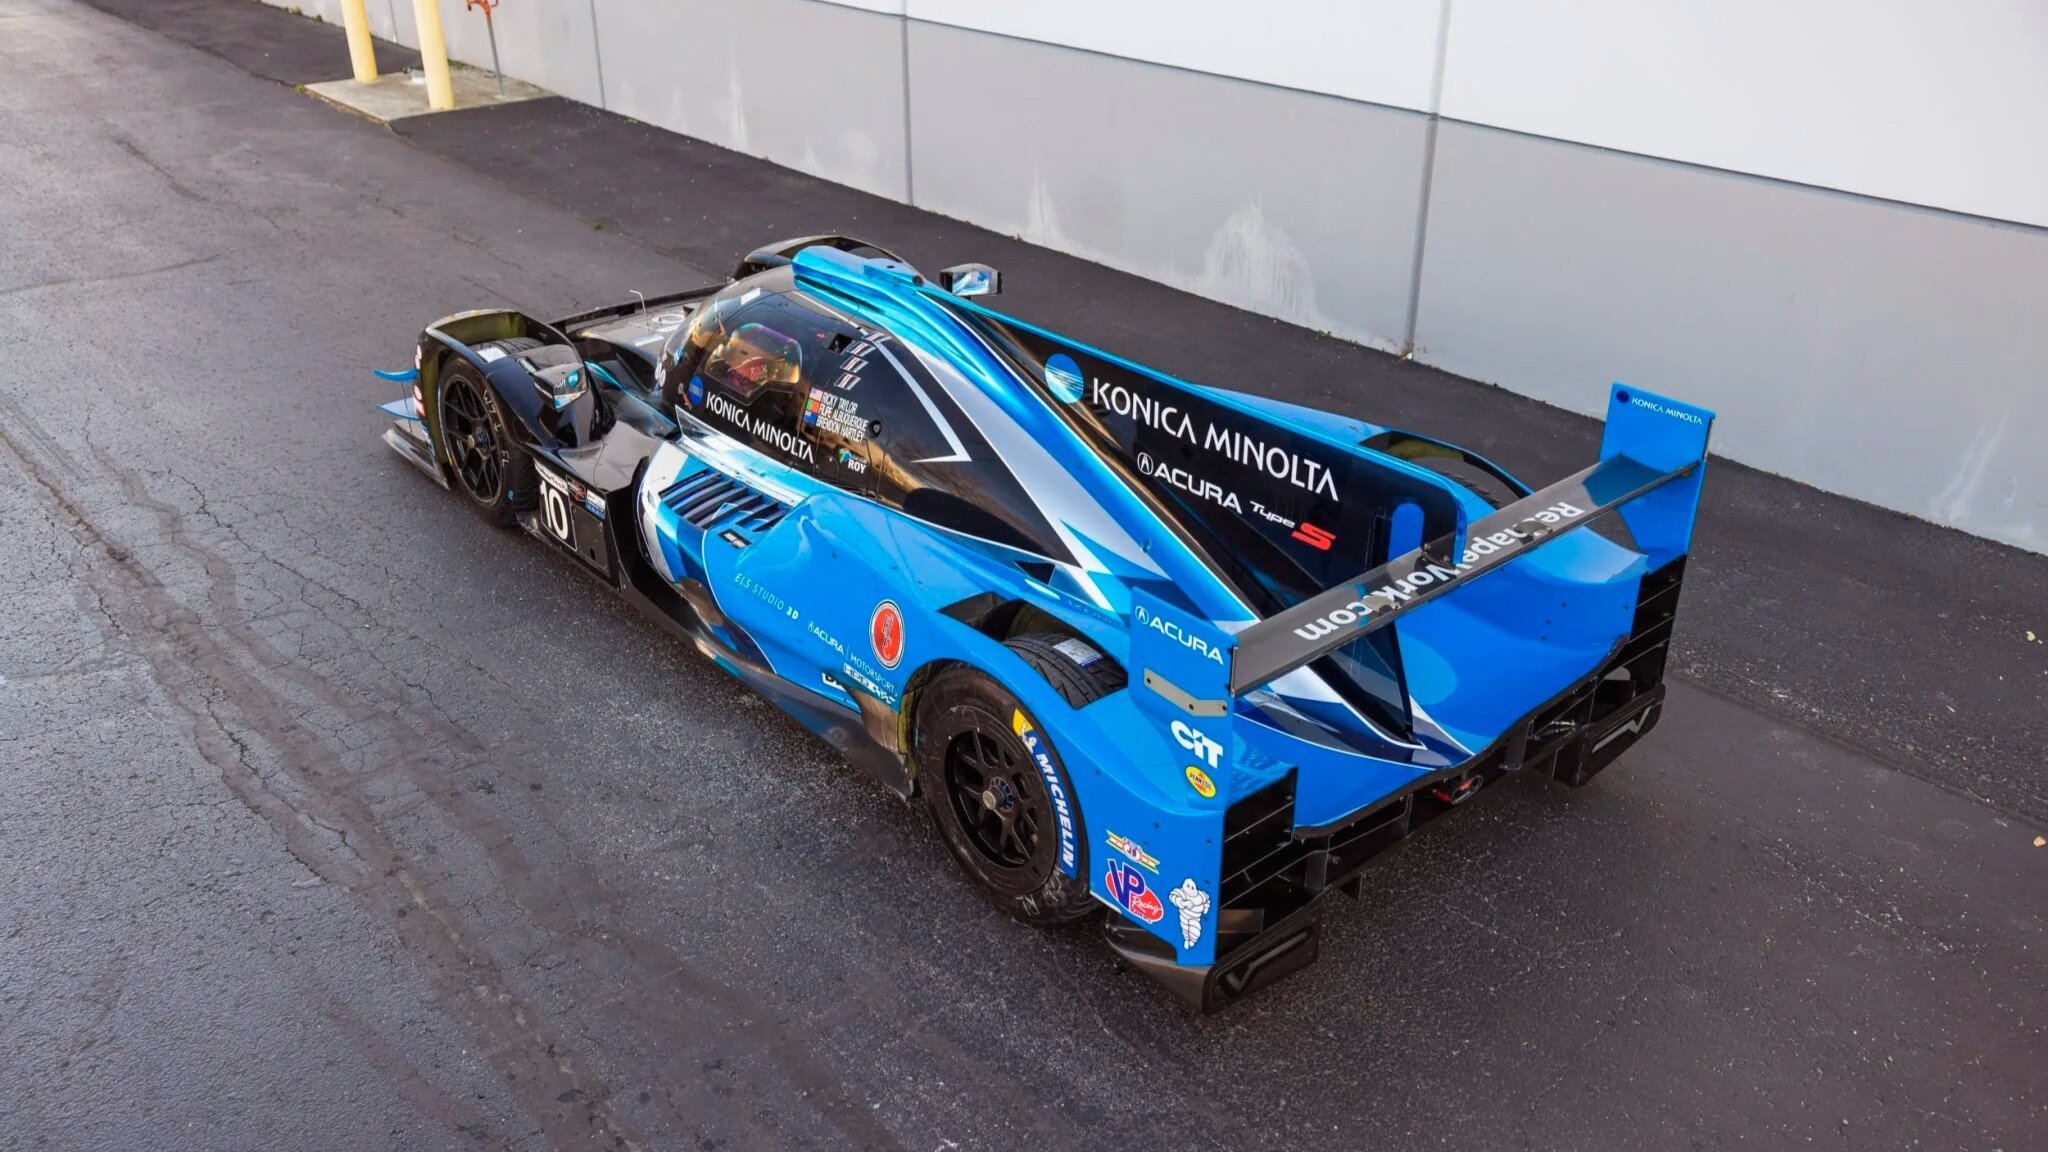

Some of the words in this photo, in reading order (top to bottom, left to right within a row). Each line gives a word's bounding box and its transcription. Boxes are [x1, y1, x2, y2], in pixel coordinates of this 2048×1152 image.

[818, 403, 834, 419] FILIPE
[832, 409, 869, 432] ALBUQUERQUE
[822, 391, 838, 408] RICKY
[838, 397, 859, 415] TAYLOR
[1631, 396, 1664, 413] KONICA
[1665, 408, 1702, 425] MINOLTA
[706, 391, 750, 432] KONICA
[753, 418, 814, 464] MINOLTA
[816, 415, 841, 435] BRENDON
[840, 422, 865, 444] HARTLEY
[1093, 378, 1197, 445] KONICA
[1204, 422, 1339, 502] MINOLTA
[848, 459, 867, 474] ROY
[540, 479, 568, 540] 10
[1154, 463, 1243, 515] ACURA
[1291, 522, 1336, 550] S
[1294, 501, 1586, 640] RehapeWorkcom
[734, 572, 751, 589] ELS
[752, 583, 785, 611] STUDIO
[786, 606, 799, 620] 3D
[813, 626, 845, 656] ACURA
[1150, 616, 1224, 666] ACURA
[1189, 772, 1213, 791] PENNZOIL
[1036, 753, 1074, 868] MICHELIN
[1107, 859, 1146, 911] VP
[1131, 895, 1162, 915] Racing
